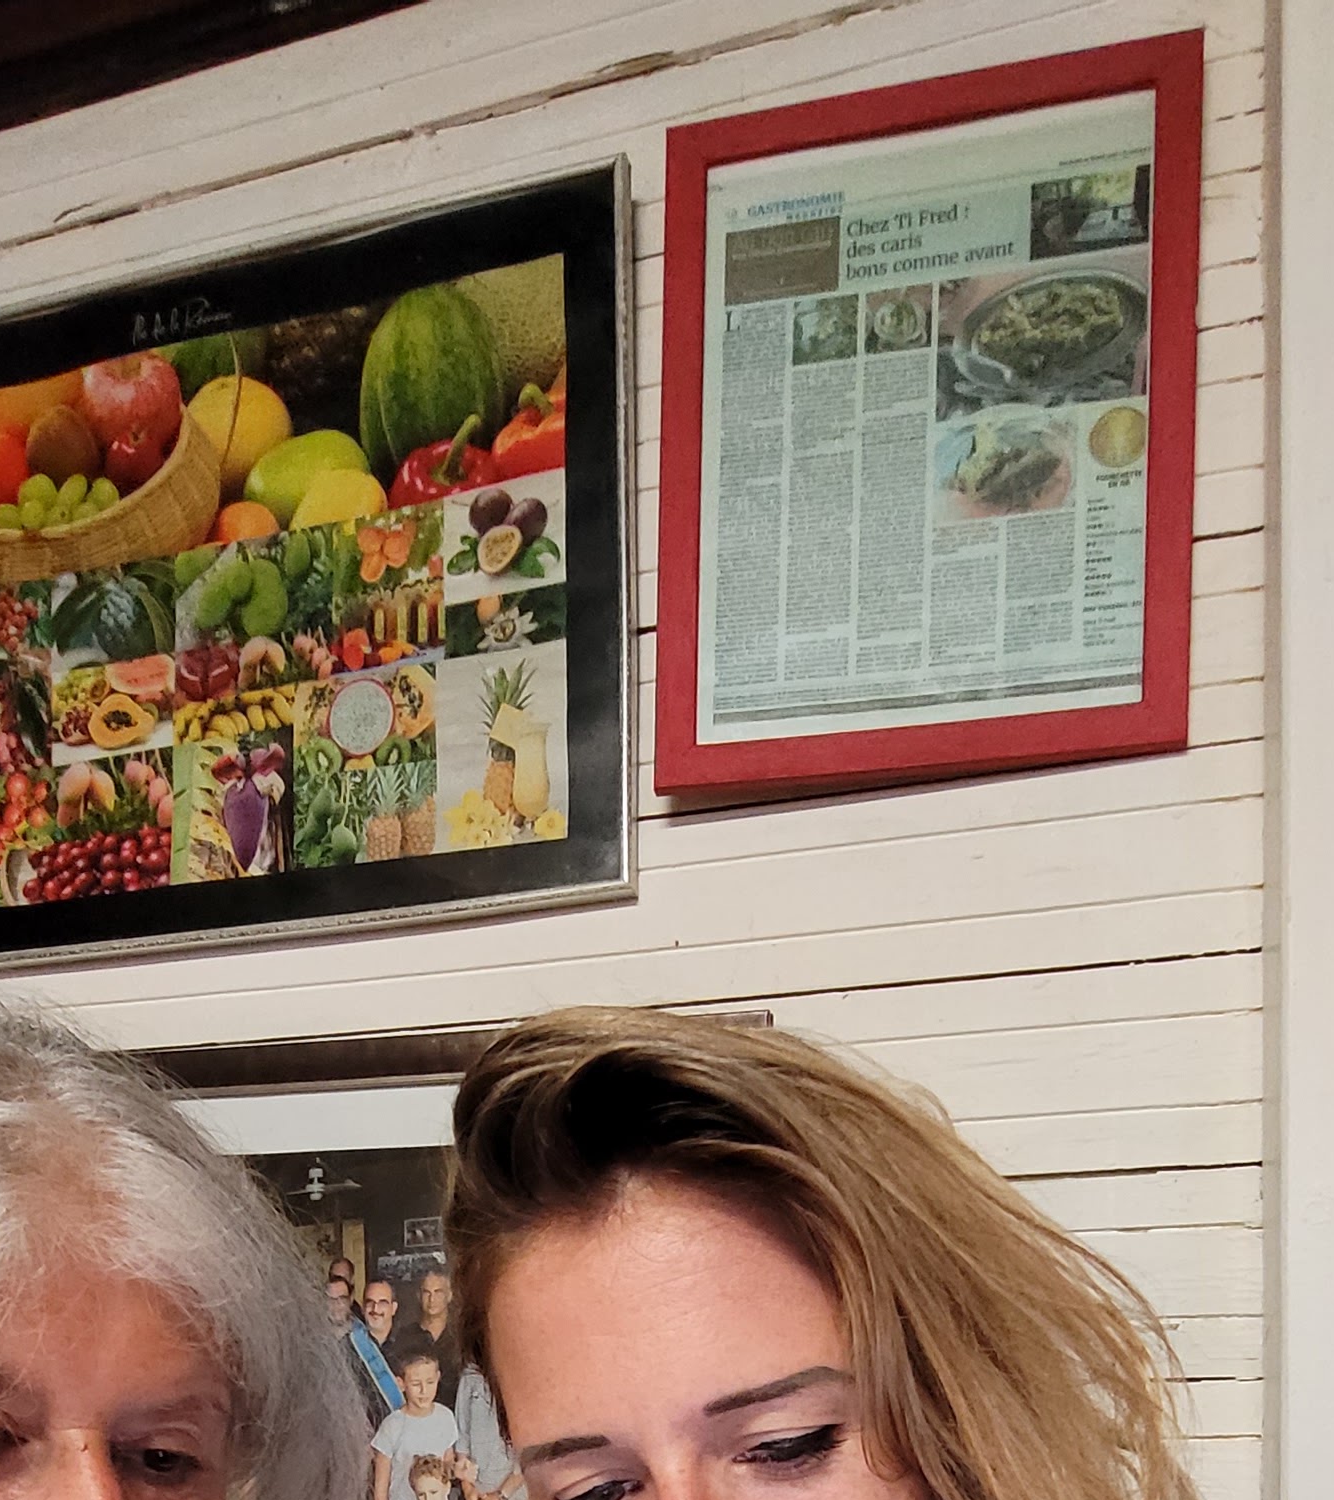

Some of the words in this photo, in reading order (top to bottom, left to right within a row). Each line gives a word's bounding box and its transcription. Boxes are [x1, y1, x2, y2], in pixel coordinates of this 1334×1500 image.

[846, 217, 891, 238] Chez
[918, 203, 959, 228] Fred
[845, 263, 888, 281] bons
[893, 250, 960, 274] comme
[964, 241, 1015, 264] avant
[846, 240, 876, 260] des
[880, 233, 924, 254] caris
